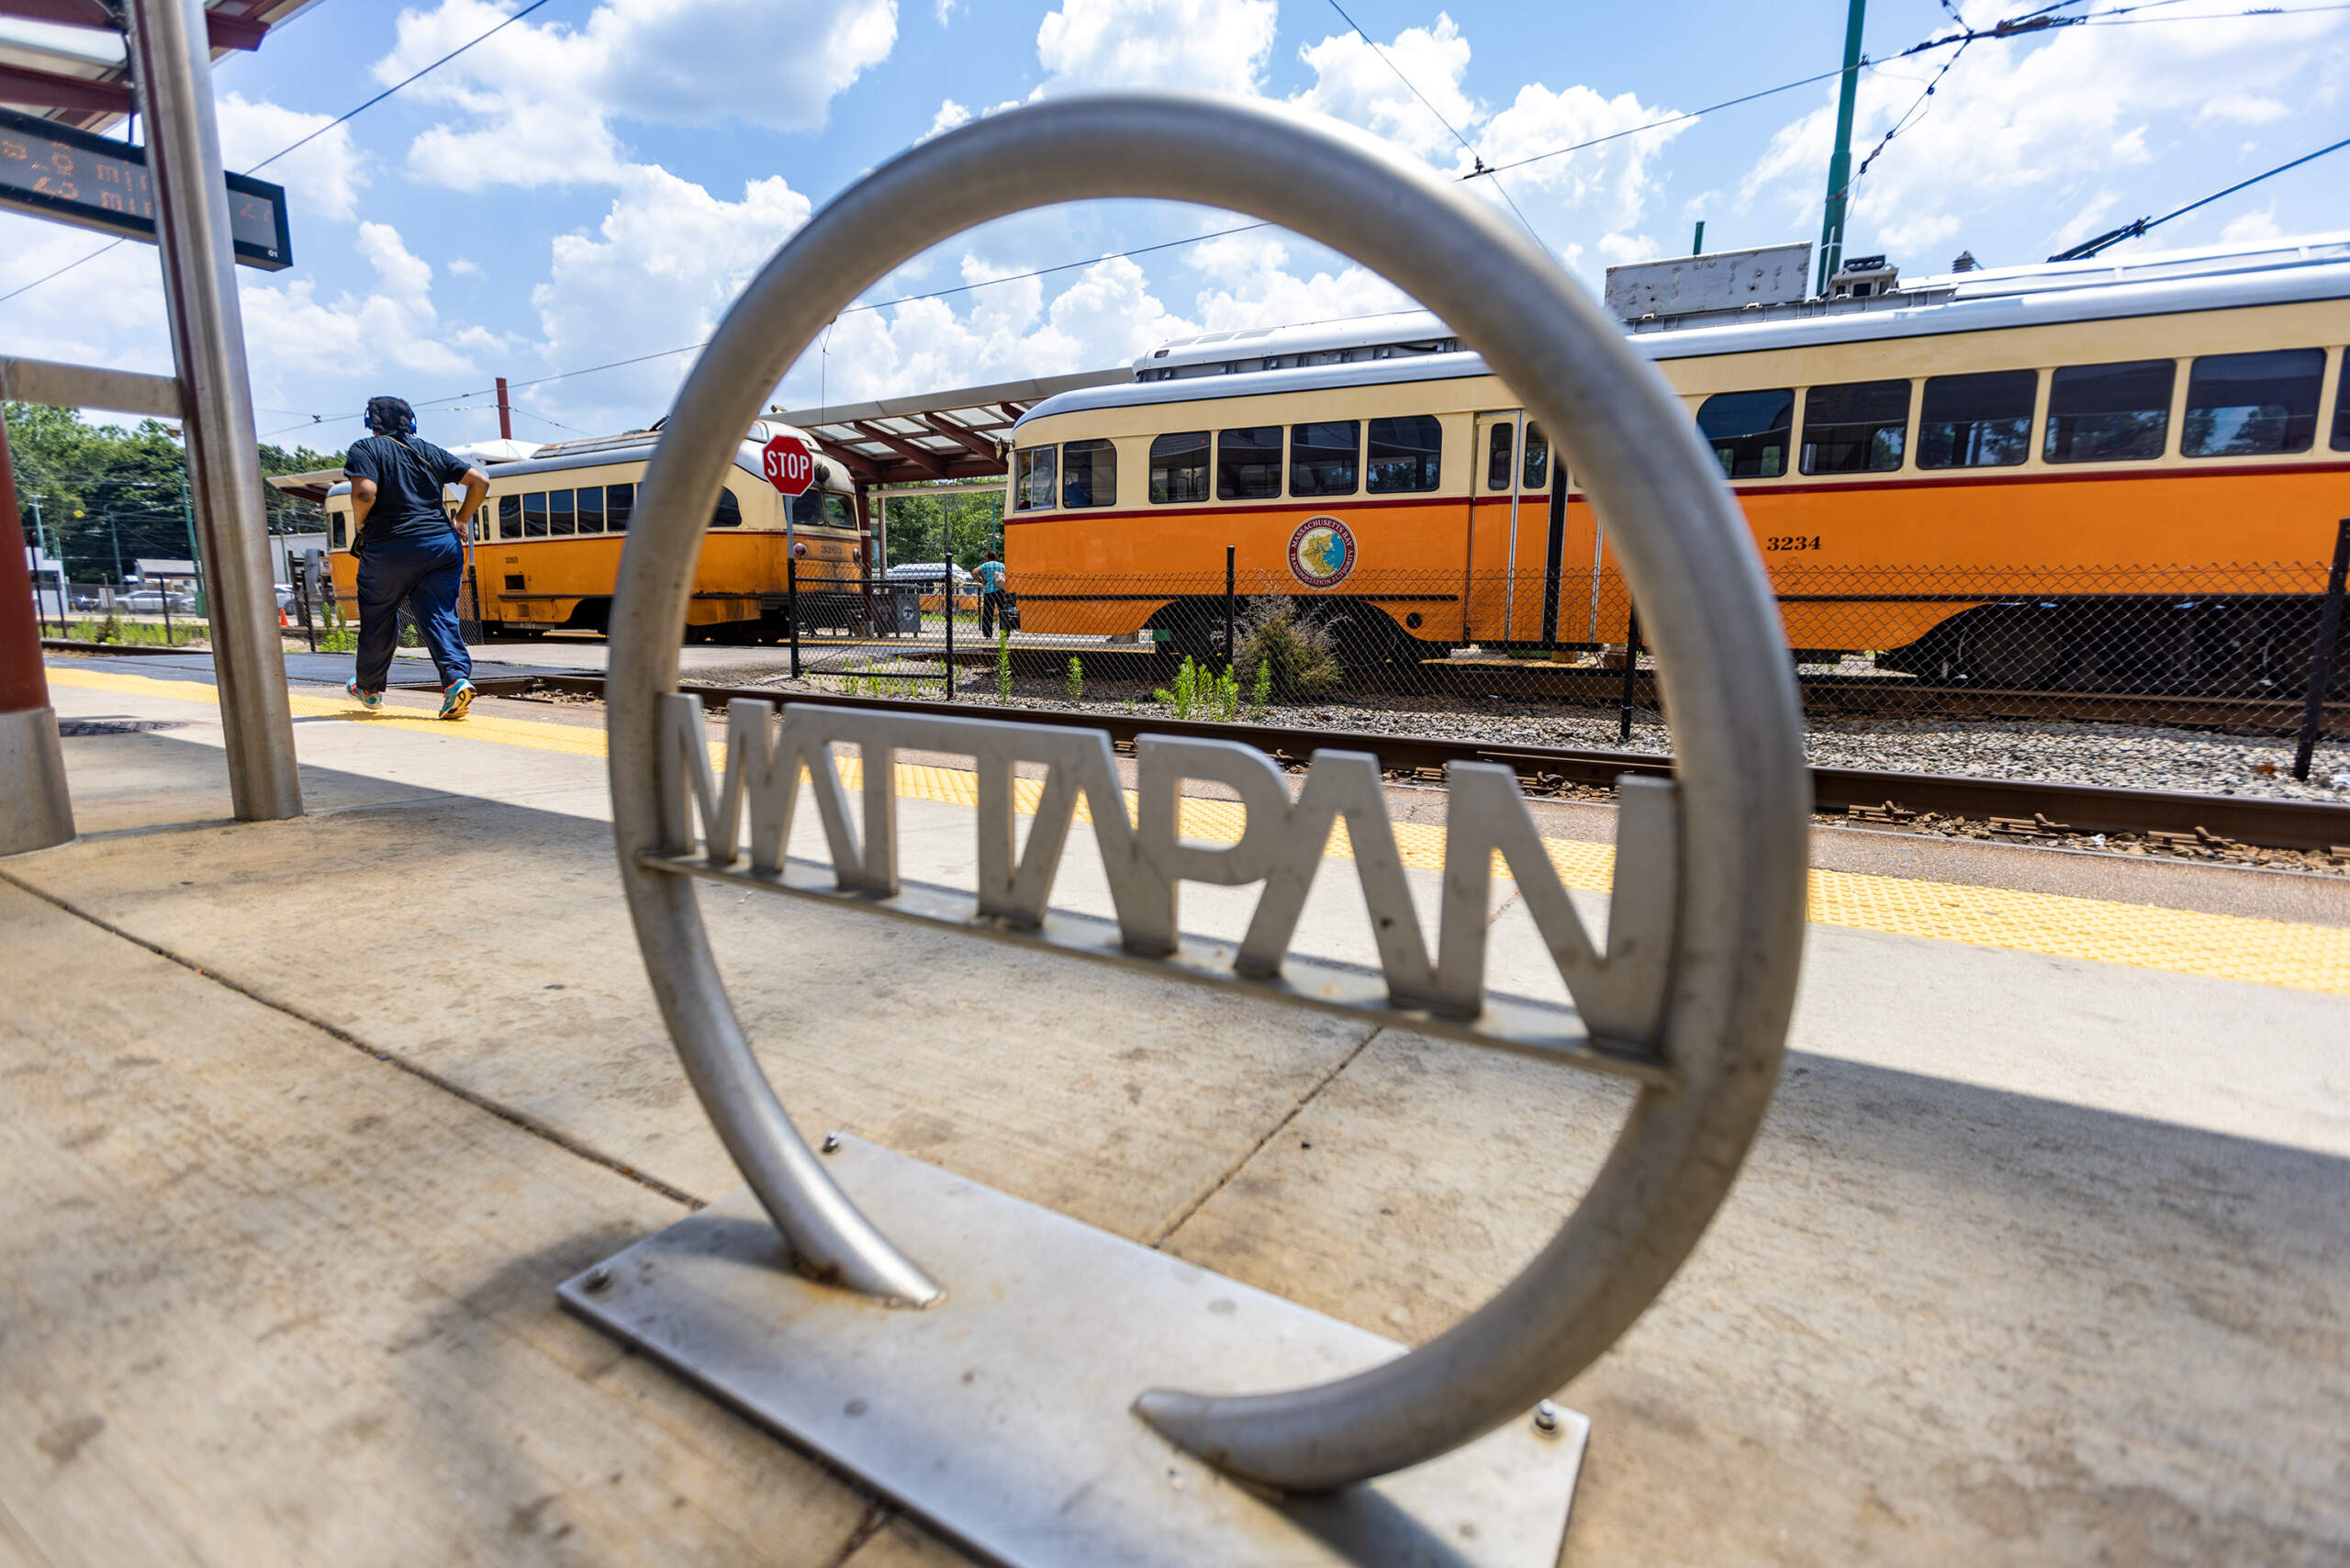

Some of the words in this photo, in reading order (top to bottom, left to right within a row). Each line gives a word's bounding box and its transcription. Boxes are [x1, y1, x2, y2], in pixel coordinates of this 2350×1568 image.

[767, 450, 810, 480] STOP
[1292, 519, 1345, 548] MASSACHUSETTS
[1342, 531, 1353, 547] BAY
[1766, 535, 1822, 551] 3234
[1290, 553, 1331, 586] TRANSPORTATION
[1331, 549, 1354, 582] AUTHORITY
[659, 691, 1684, 1063] MATTAPAN
